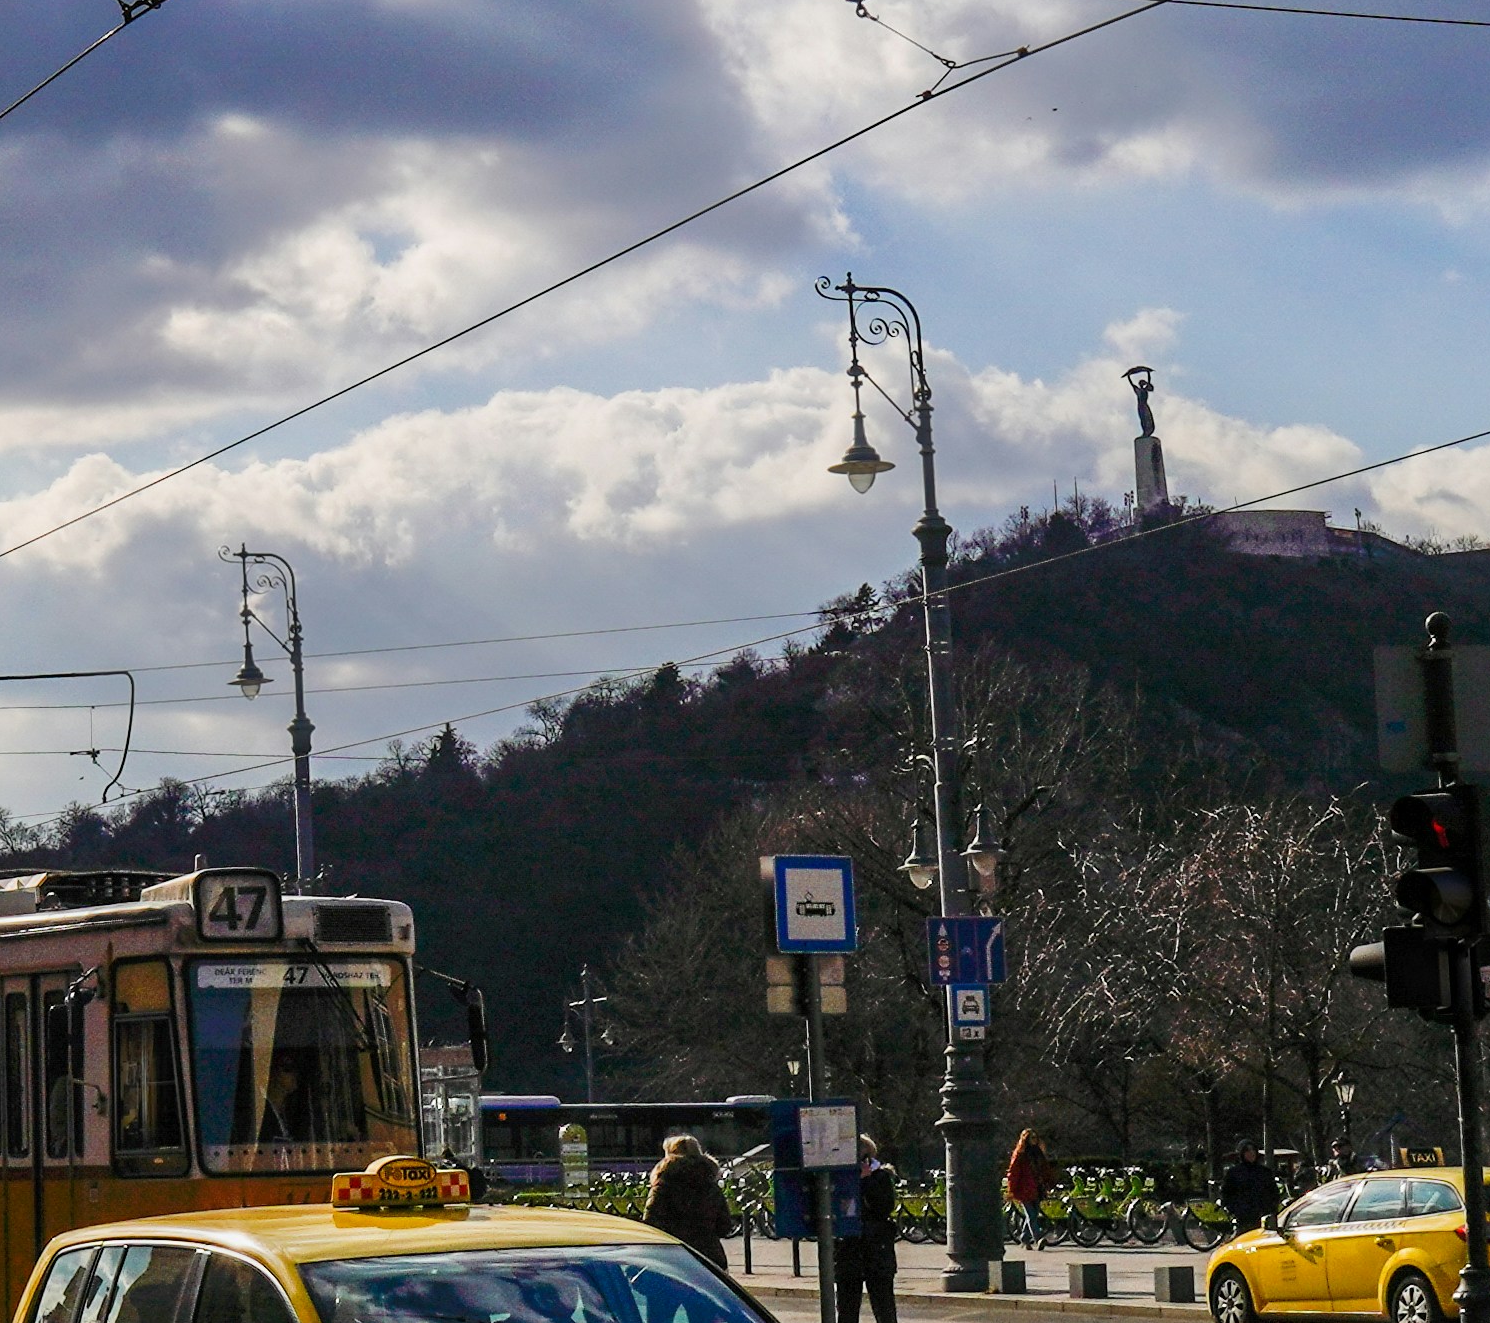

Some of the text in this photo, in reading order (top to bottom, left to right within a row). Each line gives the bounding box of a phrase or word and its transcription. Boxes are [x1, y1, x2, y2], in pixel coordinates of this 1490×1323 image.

[209, 886, 267, 931] 47
[282, 966, 309, 985] 47
[1411, 1153, 1436, 1163] TAXI
